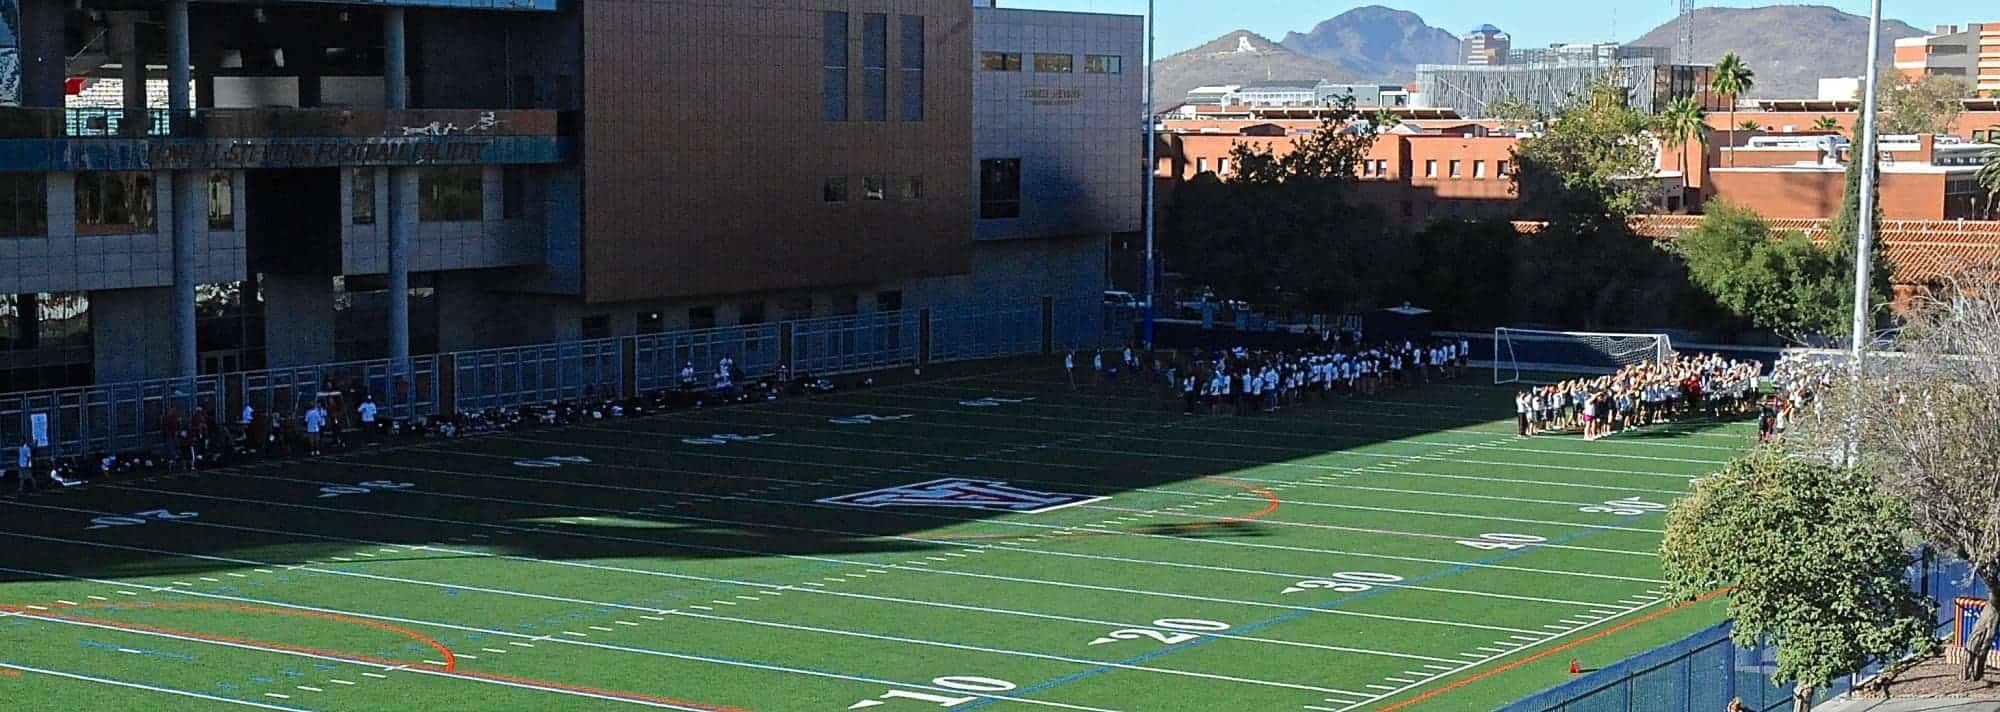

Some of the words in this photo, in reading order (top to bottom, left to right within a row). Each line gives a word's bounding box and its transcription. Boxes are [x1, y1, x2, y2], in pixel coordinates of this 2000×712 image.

[1455, 532, 1548, 550] 40
[1295, 571, 1404, 592] 30
[1109, 618, 1231, 645] 20
[879, 675, 1017, 707] 10
